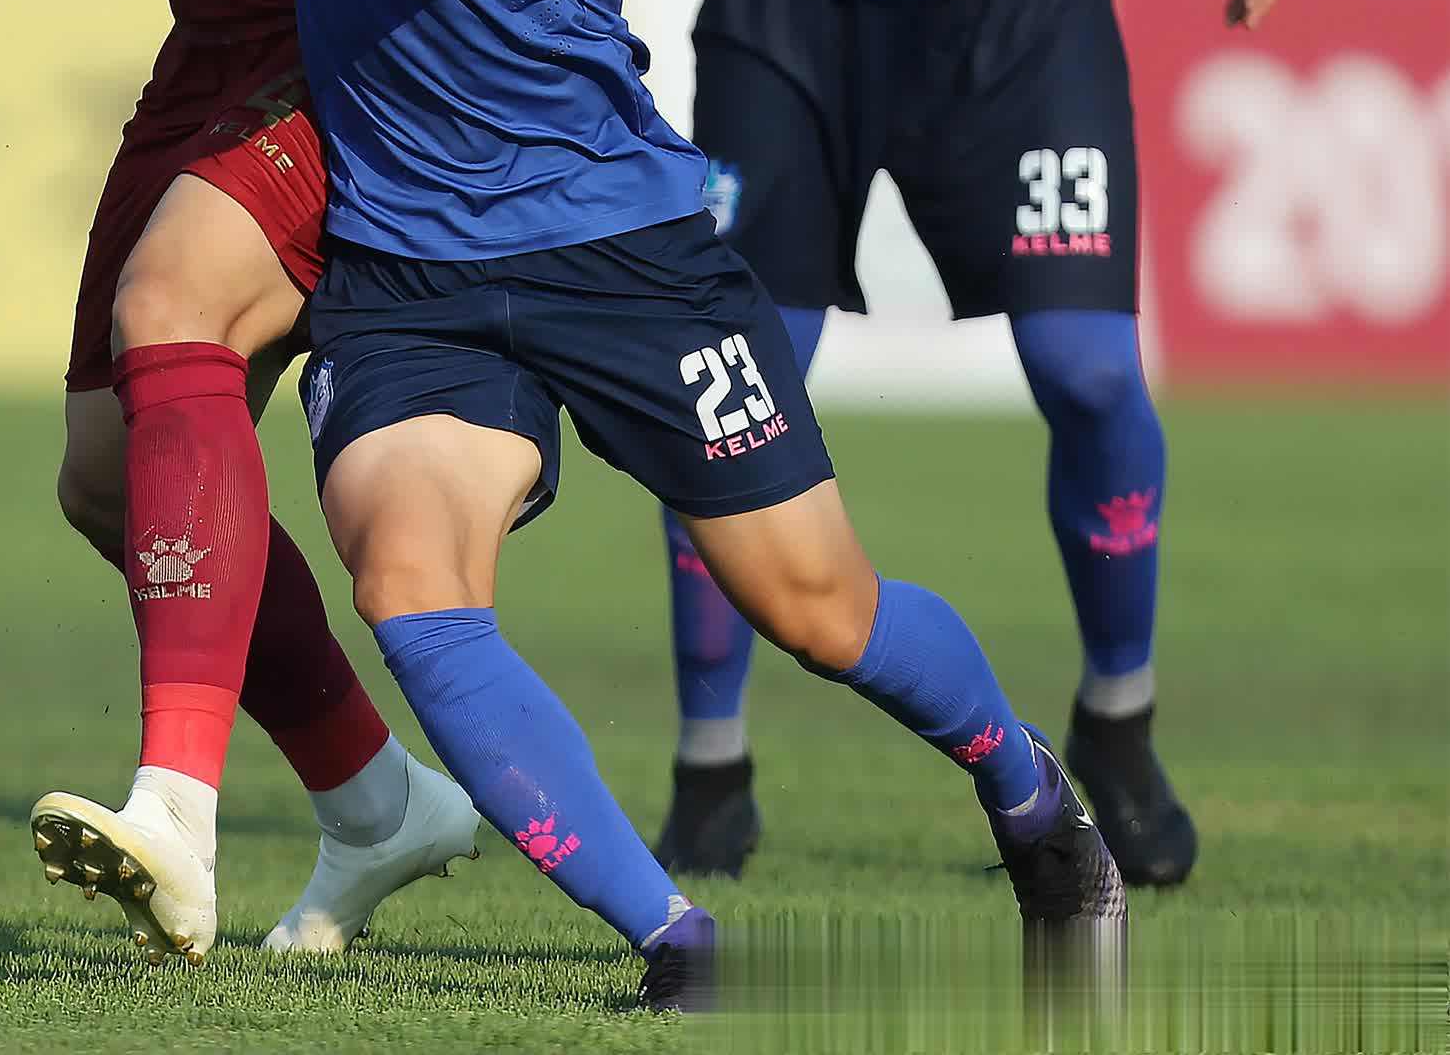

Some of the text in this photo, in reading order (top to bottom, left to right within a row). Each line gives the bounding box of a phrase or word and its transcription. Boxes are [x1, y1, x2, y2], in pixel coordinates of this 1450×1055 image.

[1016, 147, 1109, 235] 33
[1172, 49, 1450, 324] 20
[1012, 231, 1111, 256] KELME
[678, 332, 777, 443] 23
[704, 411, 790, 461] KELME
[133, 582, 212, 602] KELME
